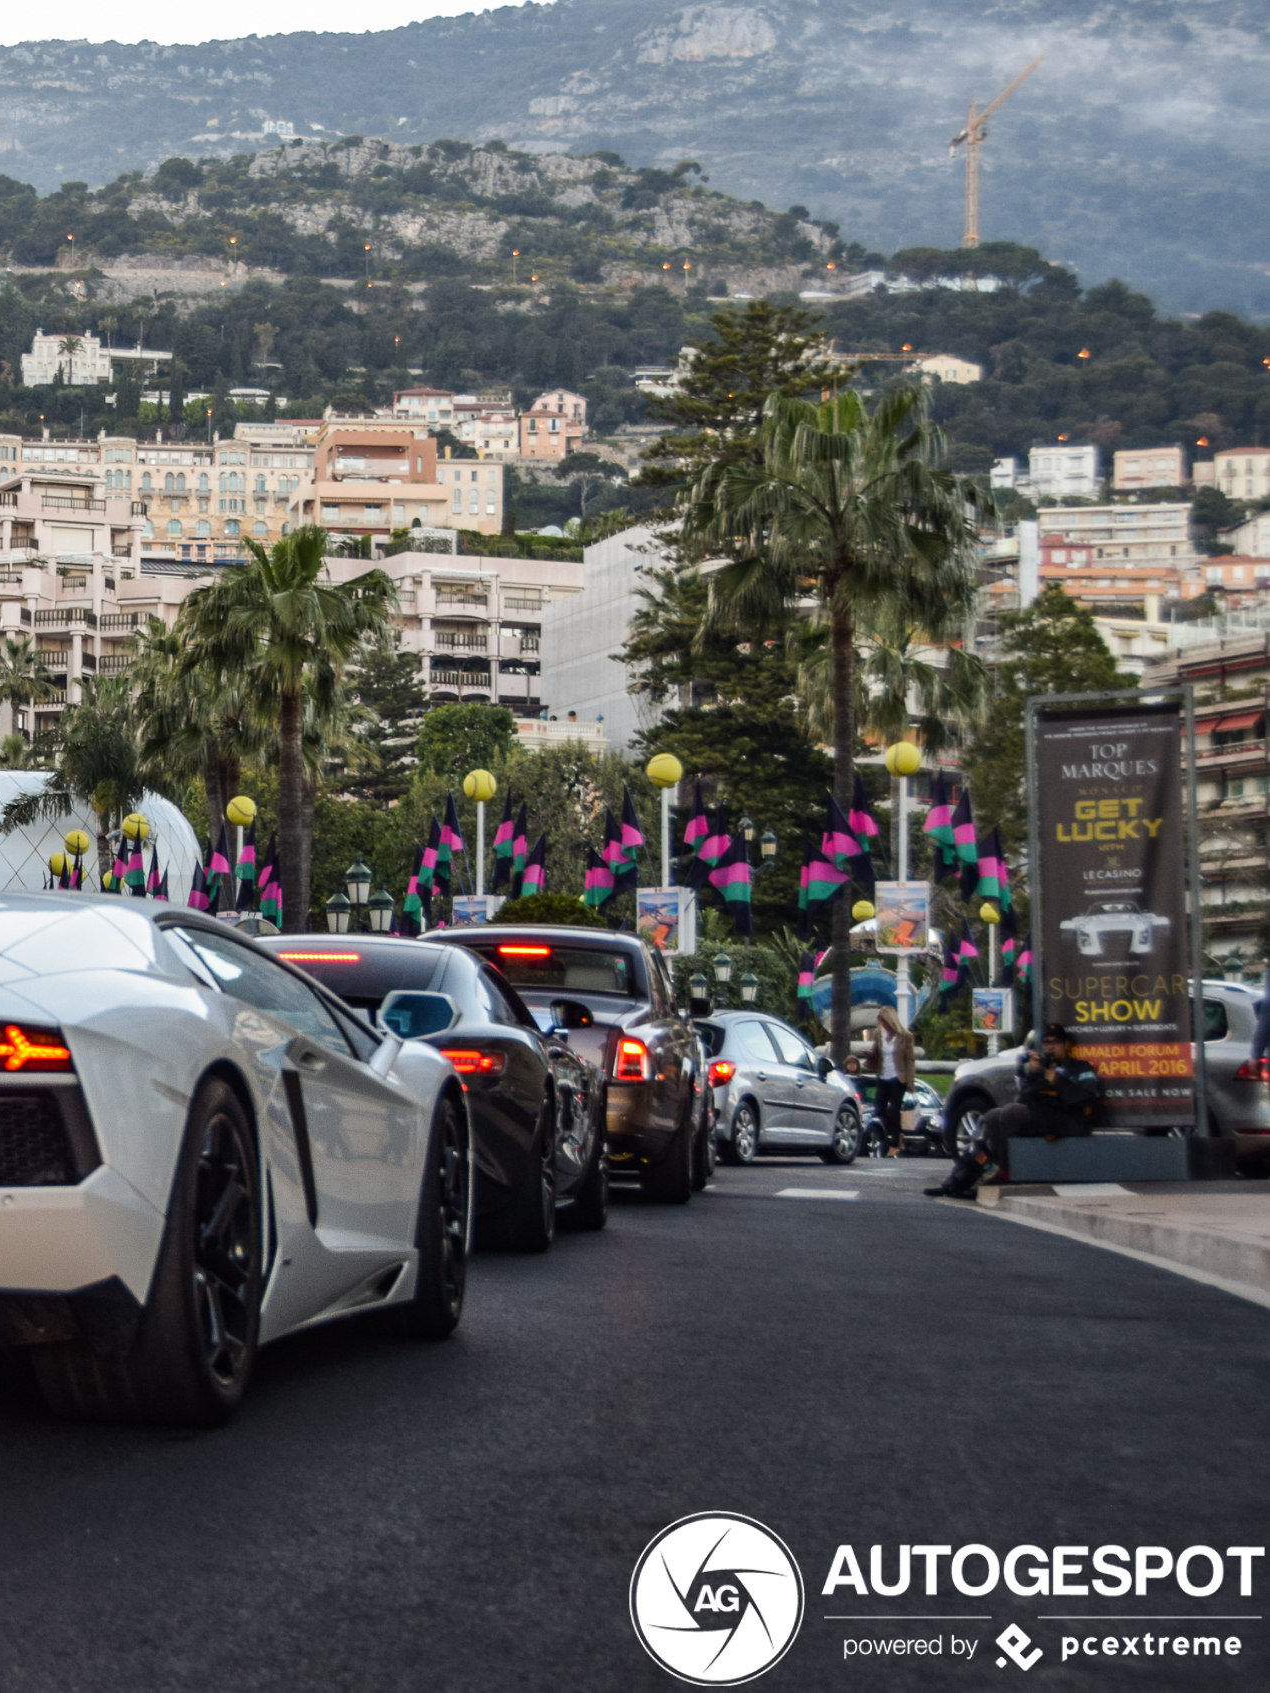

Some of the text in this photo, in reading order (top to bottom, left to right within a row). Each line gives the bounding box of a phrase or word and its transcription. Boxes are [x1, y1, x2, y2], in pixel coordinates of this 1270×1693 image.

[1089, 743, 1127, 759] TOP
[1061, 760, 1158, 780] MARQUES
[1075, 798, 1143, 819] GET
[1056, 818, 1163, 841] LUCKY
[1083, 868, 1142, 880] LE CASINO
[1049, 974, 1187, 1000] SUPERCAR
[1075, 999, 1161, 1022] SHOW
[1133, 1023, 1177, 1032] SUPERBOATS
[1130, 1045, 1180, 1057] FORUM
[1098, 1059, 1188, 1076] APRIL 2016
[1105, 1087, 1192, 1098] ON SALE NOW
